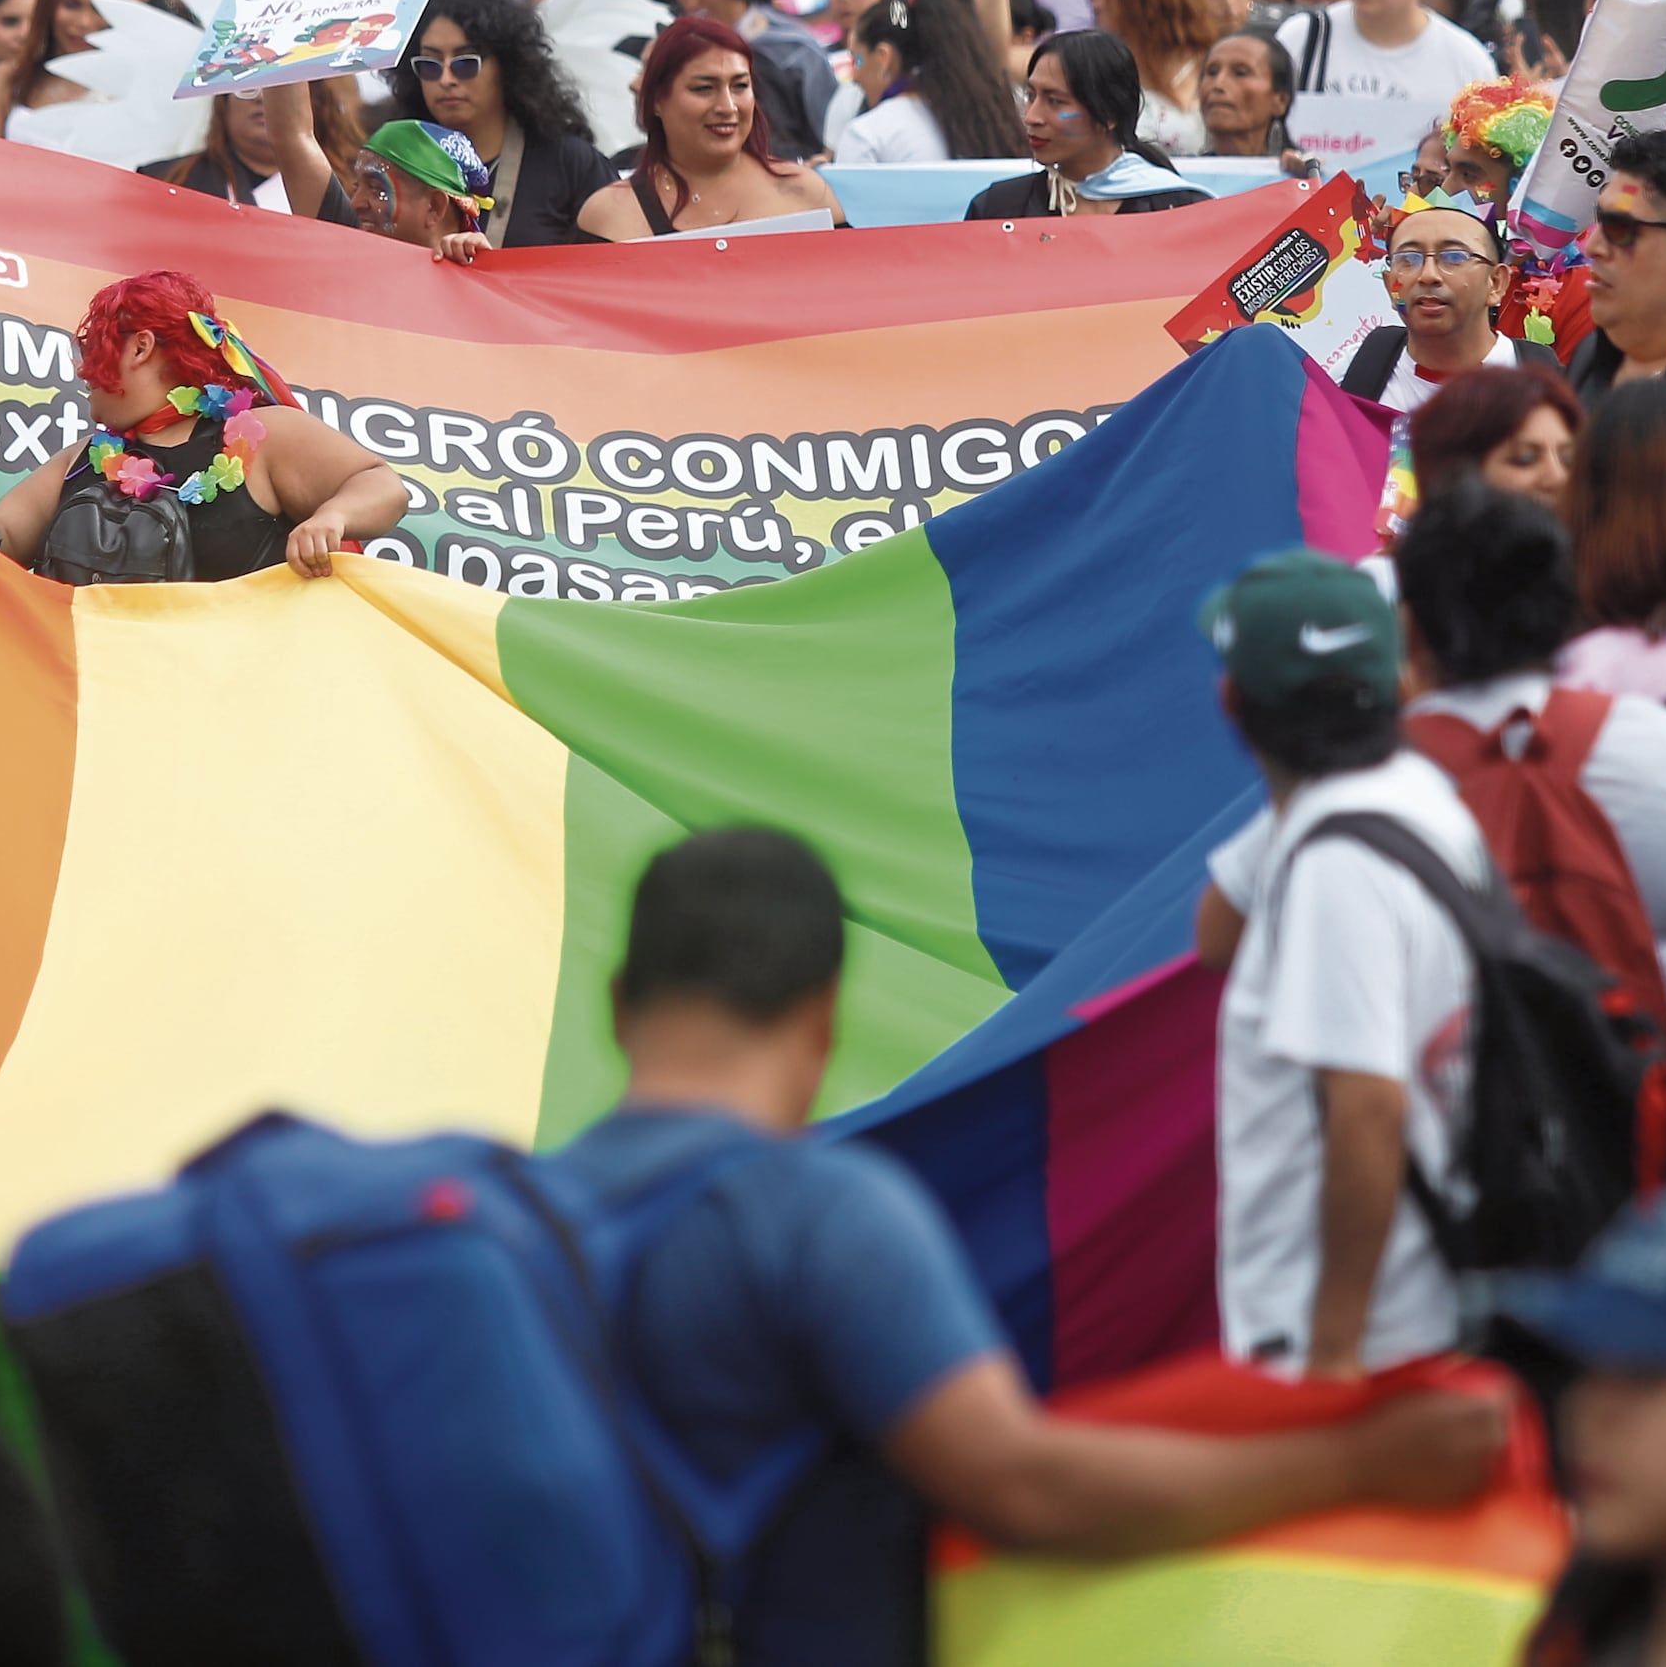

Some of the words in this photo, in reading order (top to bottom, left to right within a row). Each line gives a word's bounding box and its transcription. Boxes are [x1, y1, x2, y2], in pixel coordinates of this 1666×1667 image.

[239, 15, 287, 30] TIENE
[259, 0, 303, 17] NO
[1236, 265, 1279, 304] EXISTIR
[1273, 251, 1295, 273] CON
[1291, 238, 1310, 258] LOS
[1243, 285, 1277, 316] MISMOS
[1274, 247, 1320, 289] DERECHOS?
[293, 391, 569, 478] IGRÓ
[456, 487, 532, 536] al
[565, 492, 812, 565] Perú,
